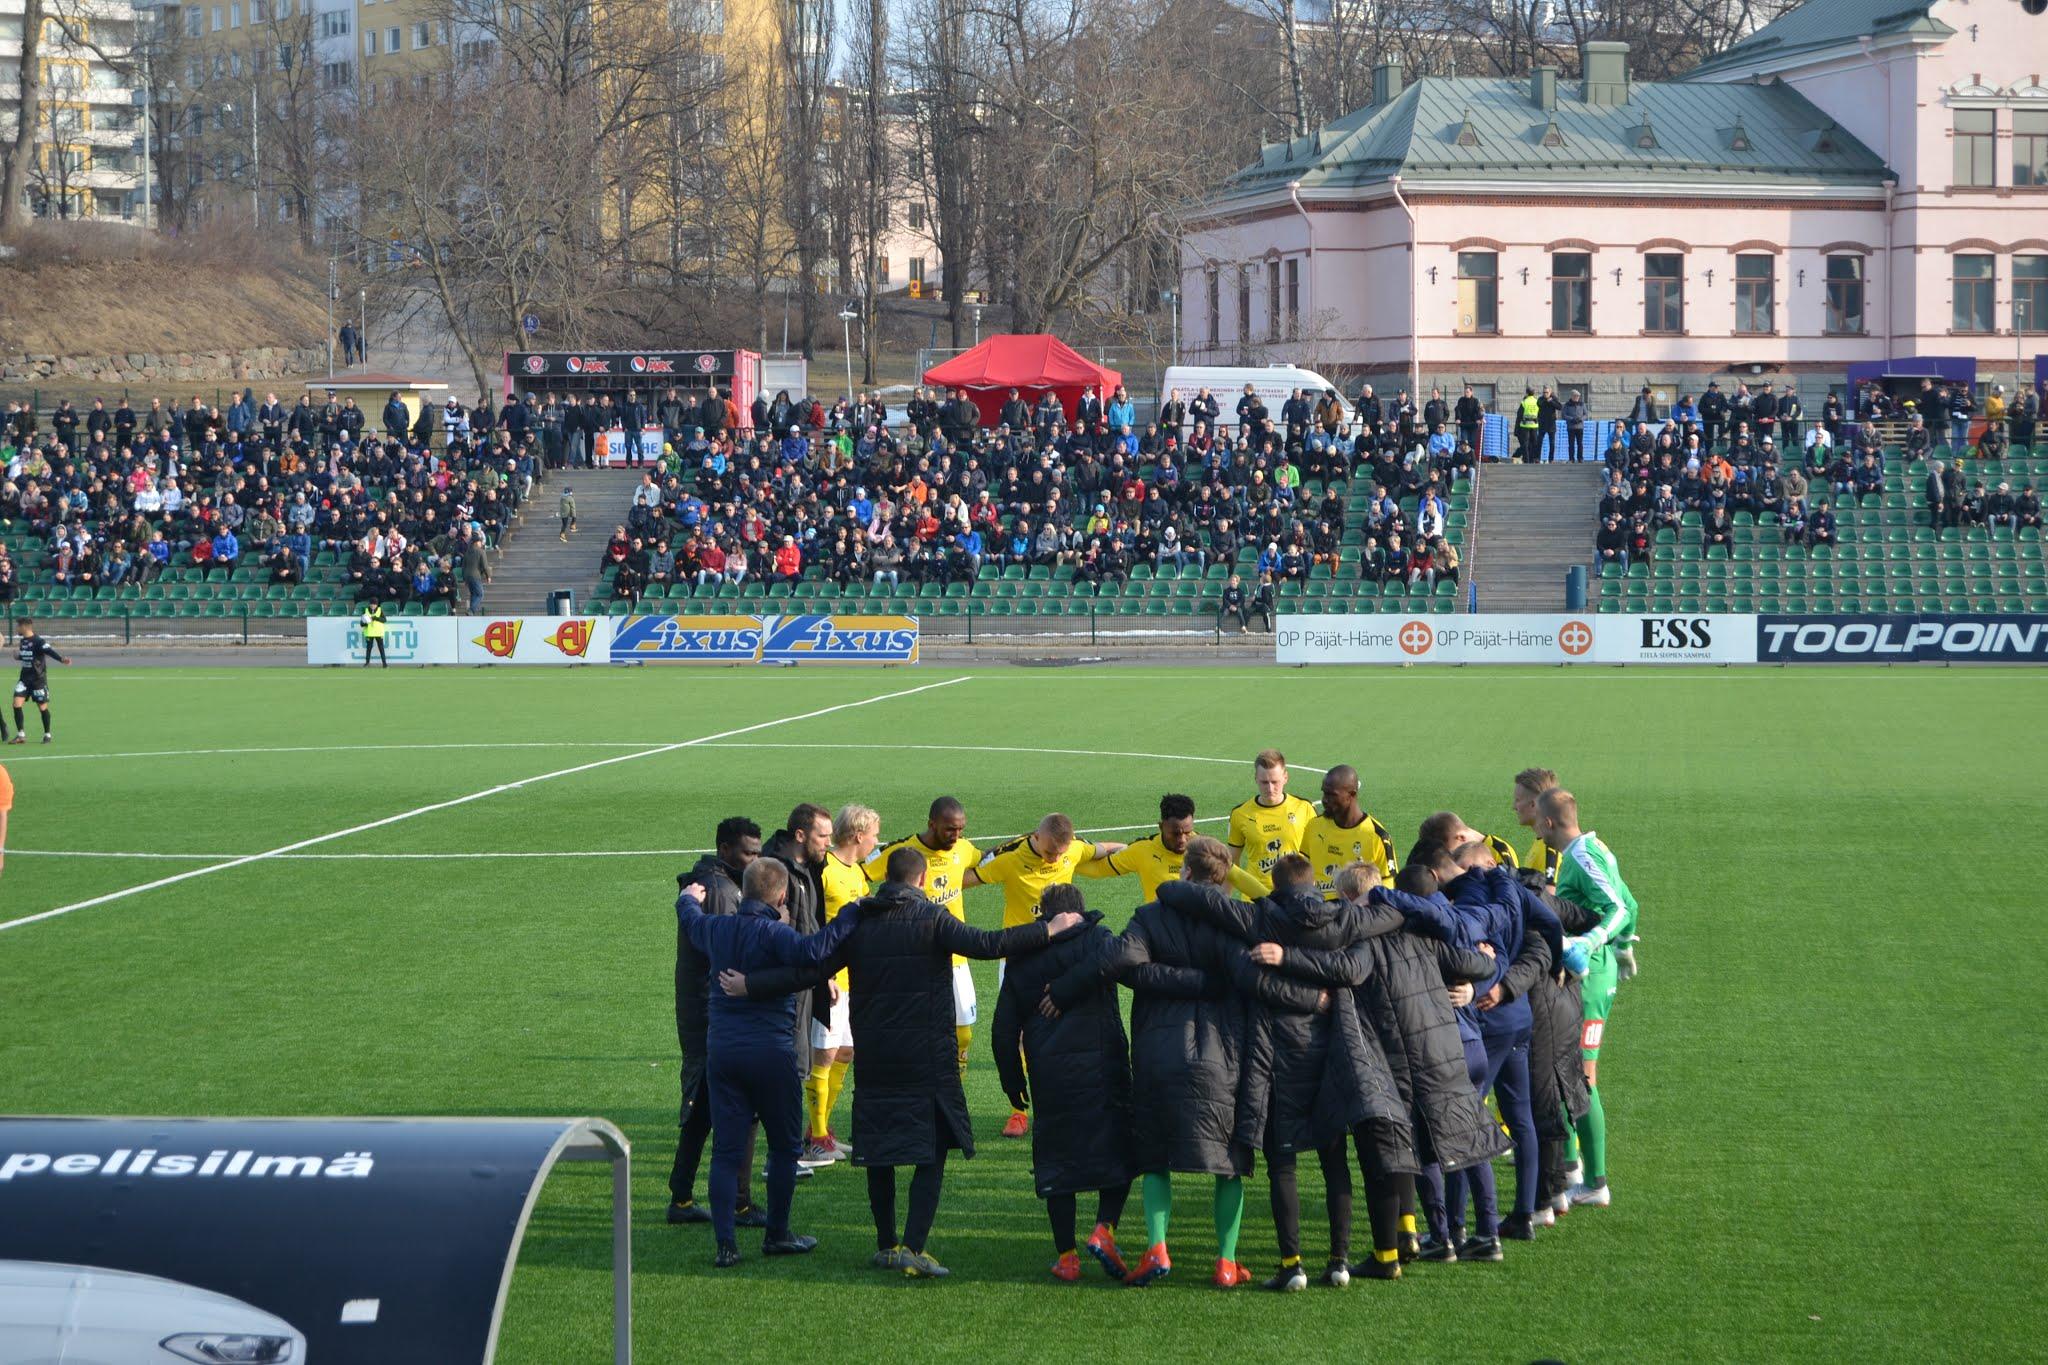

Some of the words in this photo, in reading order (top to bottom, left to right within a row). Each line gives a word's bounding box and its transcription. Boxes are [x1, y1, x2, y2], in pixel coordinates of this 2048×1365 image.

[610, 616, 763, 651] Fixus
[763, 616, 917, 651] Fixus
[1278, 631, 1300, 647] OP
[1305, 630, 1393, 650] Päijät-Häme
[1437, 631, 1459, 647] OP
[1464, 630, 1553, 650] Päijät-Häme
[1640, 618, 1711, 648] ESS
[1763, 623, 2048, 653] TOOLPOIN
[0, 1149, 374, 1181] pelisilmä
